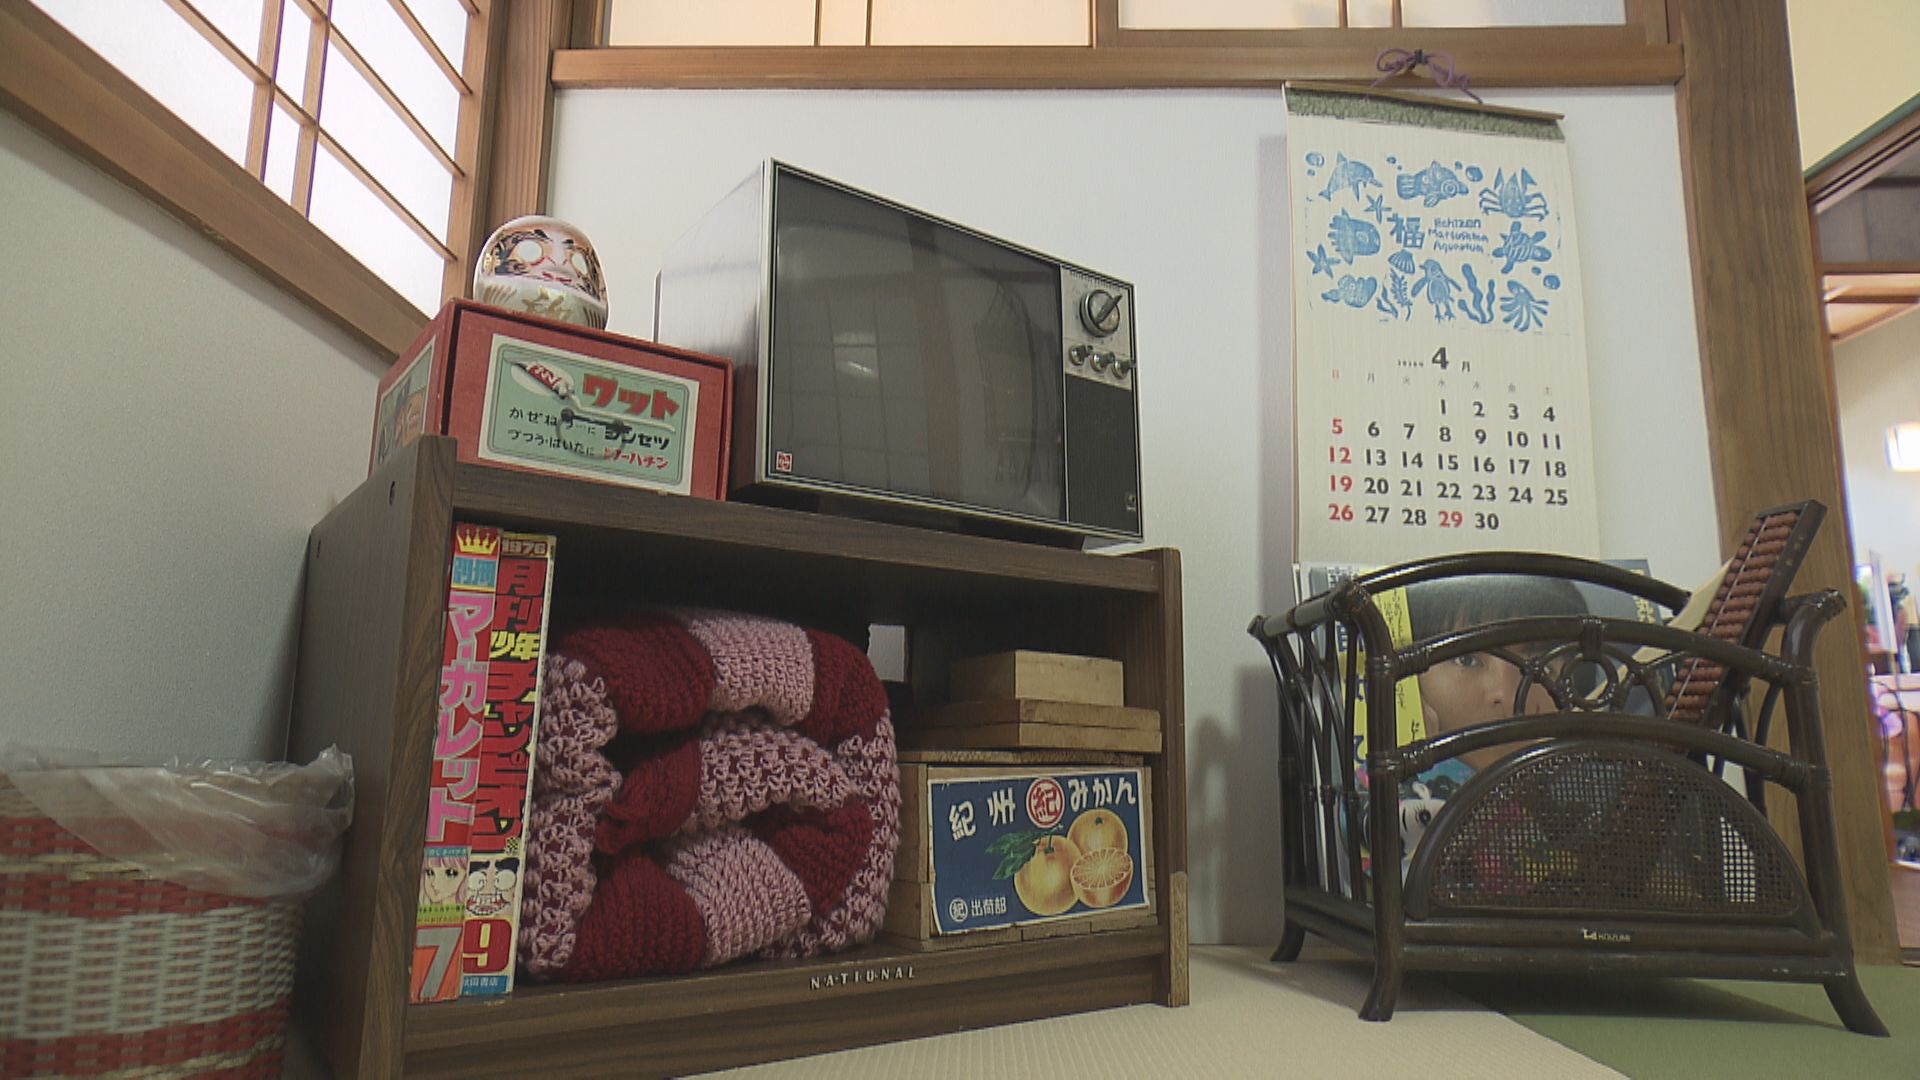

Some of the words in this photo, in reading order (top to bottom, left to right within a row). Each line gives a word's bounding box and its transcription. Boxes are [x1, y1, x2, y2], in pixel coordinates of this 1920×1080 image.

[1387, 213, 1425, 250] 福
[1431, 346, 1450, 370] 4
[582, 373, 680, 420] ワット
[1440, 398, 1447, 415] 1
[1472, 401, 1486, 418] 2
[1508, 403, 1519, 420] 3
[1542, 406, 1556, 423] 4
[1331, 418, 1343, 435] 5
[1367, 421, 1380, 438] 6
[1403, 423, 1415, 440] 7
[1439, 426, 1452, 443] 8
[1474, 428, 1487, 445] 9
[1507, 430, 1529, 448] 10
[1542, 433, 1561, 450] 11
[1329, 445, 1352, 464] 12
[1365, 448, 1387, 466] 13
[1401, 450, 1423, 469] 14
[1437, 453, 1459, 471] 15
[1473, 455, 1496, 473] 16
[1509, 458, 1530, 475] 17
[1544, 460, 1567, 478] 18
[1330, 474, 1353, 492] 19
[1363, 476, 1389, 495] 20
[1400, 479, 1422, 497] 21
[1436, 480, 1462, 500] 22
[1472, 483, 1497, 502] 23
[1508, 486, 1534, 504] 24
[1544, 488, 1568, 506] 25
[1328, 503, 1354, 522] 26
[1364, 505, 1390, 524] 27
[1401, 508, 1427, 526] 28
[1438, 510, 1463, 528] 29
[1474, 512, 1499, 530] 30
[425, 591, 495, 843] マーガレット
[949, 787, 1016, 841] 紀州
[1069, 776, 1137, 812] みかん
[416, 927, 463, 999] 7
[463, 919, 512, 974] 9
[809, 964, 916, 992] NATIONAL
